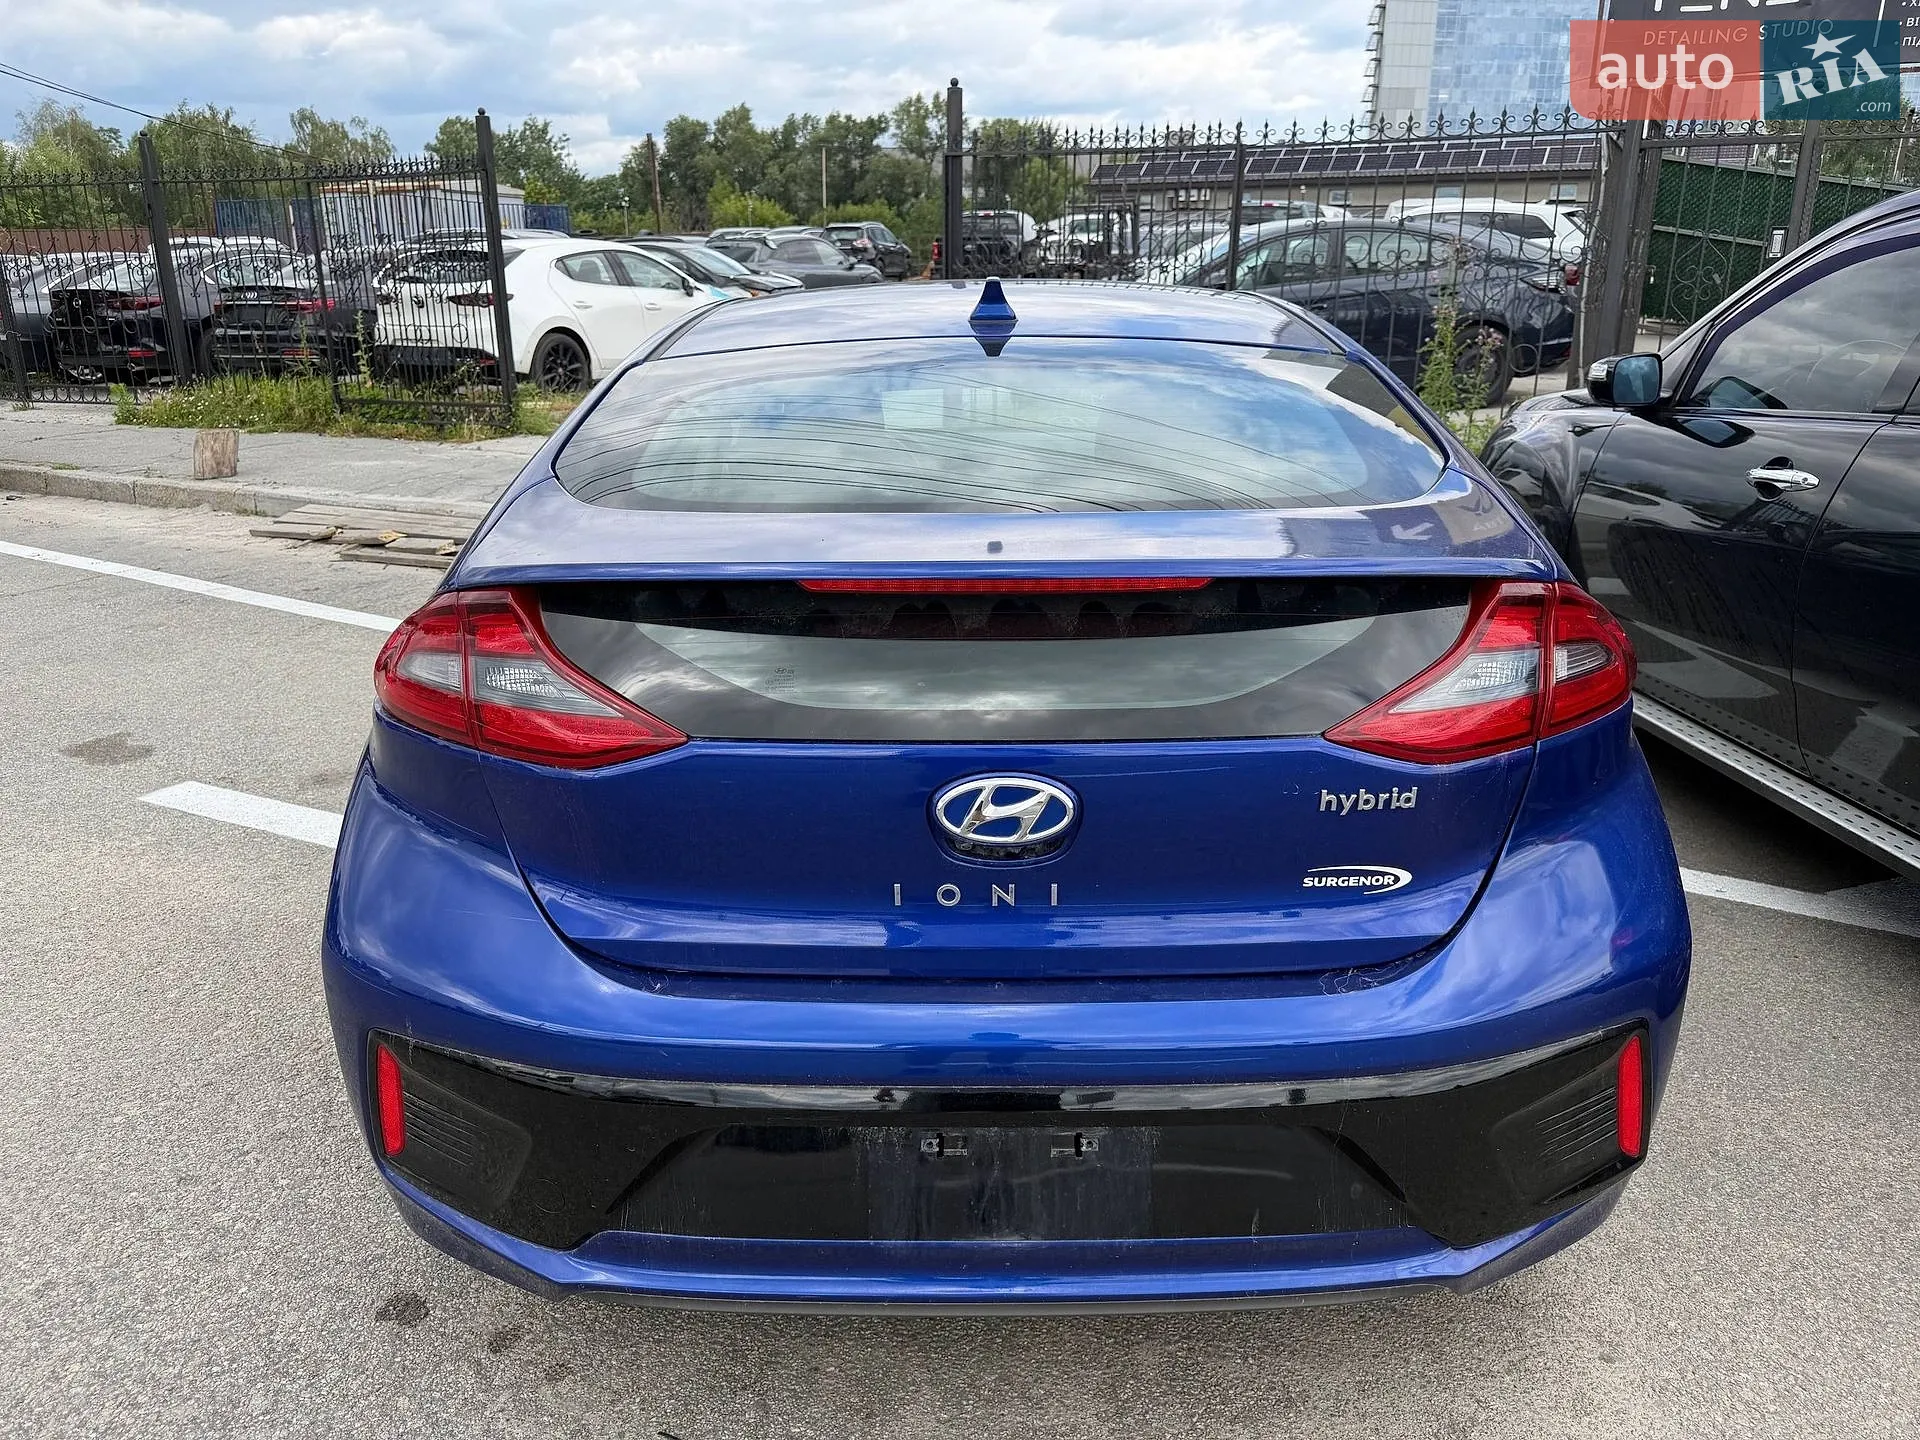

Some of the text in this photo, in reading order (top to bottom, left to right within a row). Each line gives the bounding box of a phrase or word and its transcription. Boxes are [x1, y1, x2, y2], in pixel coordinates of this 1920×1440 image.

[1643, 19, 1834, 46] DETAILING STUDIO
[1319, 786, 1418, 816] hybrid
[1302, 875, 1395, 887] SURGENOR
